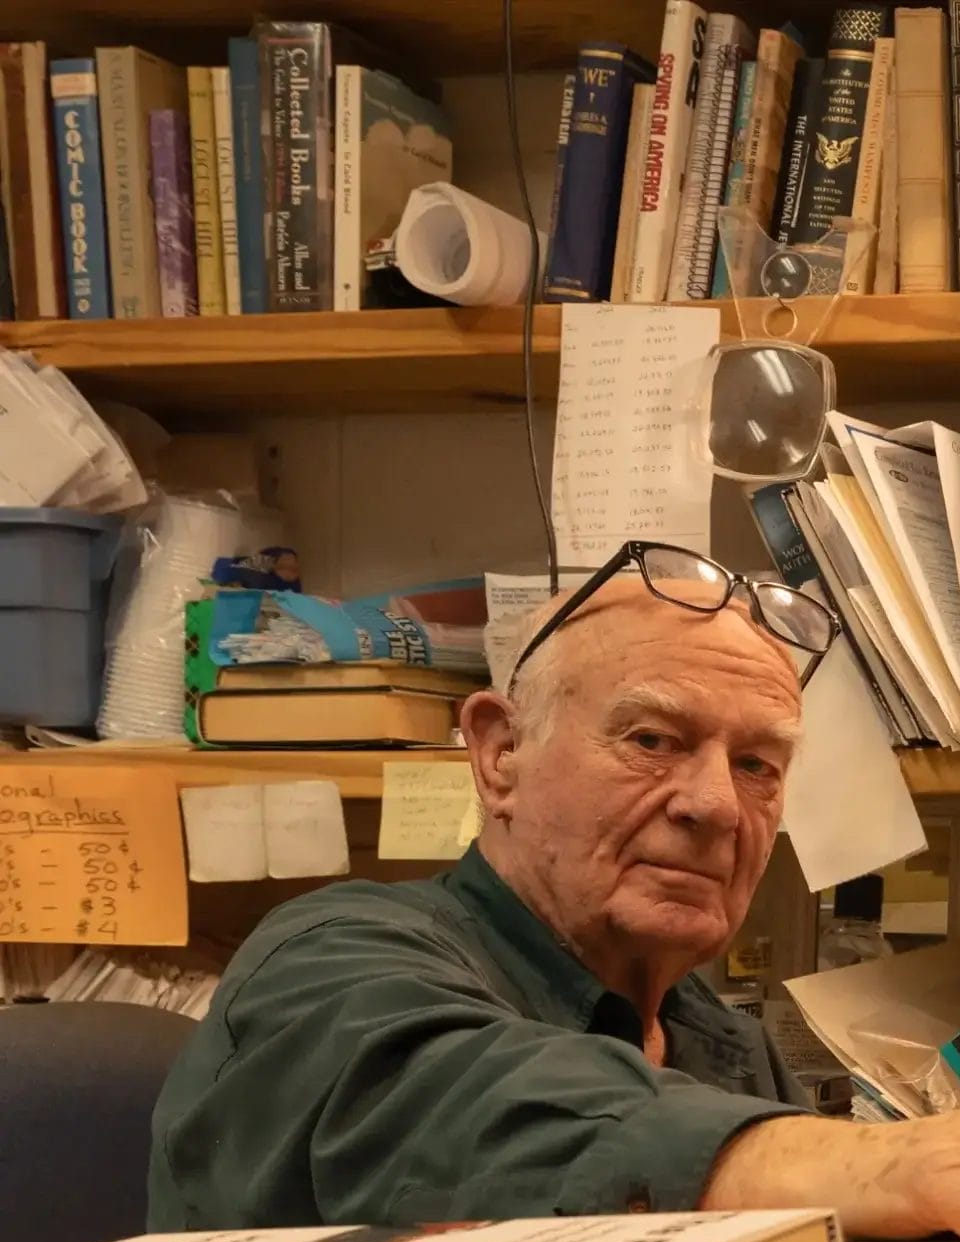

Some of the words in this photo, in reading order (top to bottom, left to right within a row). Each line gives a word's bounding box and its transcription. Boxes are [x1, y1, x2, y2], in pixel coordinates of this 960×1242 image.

[287, 47, 311, 140] Collected
[653, 53, 675, 111] SPYING
[63, 110, 86, 198] COMIC
[649, 114, 669, 137] ON
[796, 114, 808, 137] THE
[290, 148, 312, 207] Books
[639, 139, 666, 213] AMERICA
[779, 139, 805, 226] INTERNATIONAL
[70, 202, 89, 274] BOOK
[294, 241, 311, 271] Allen
[295, 271, 311, 291] and
